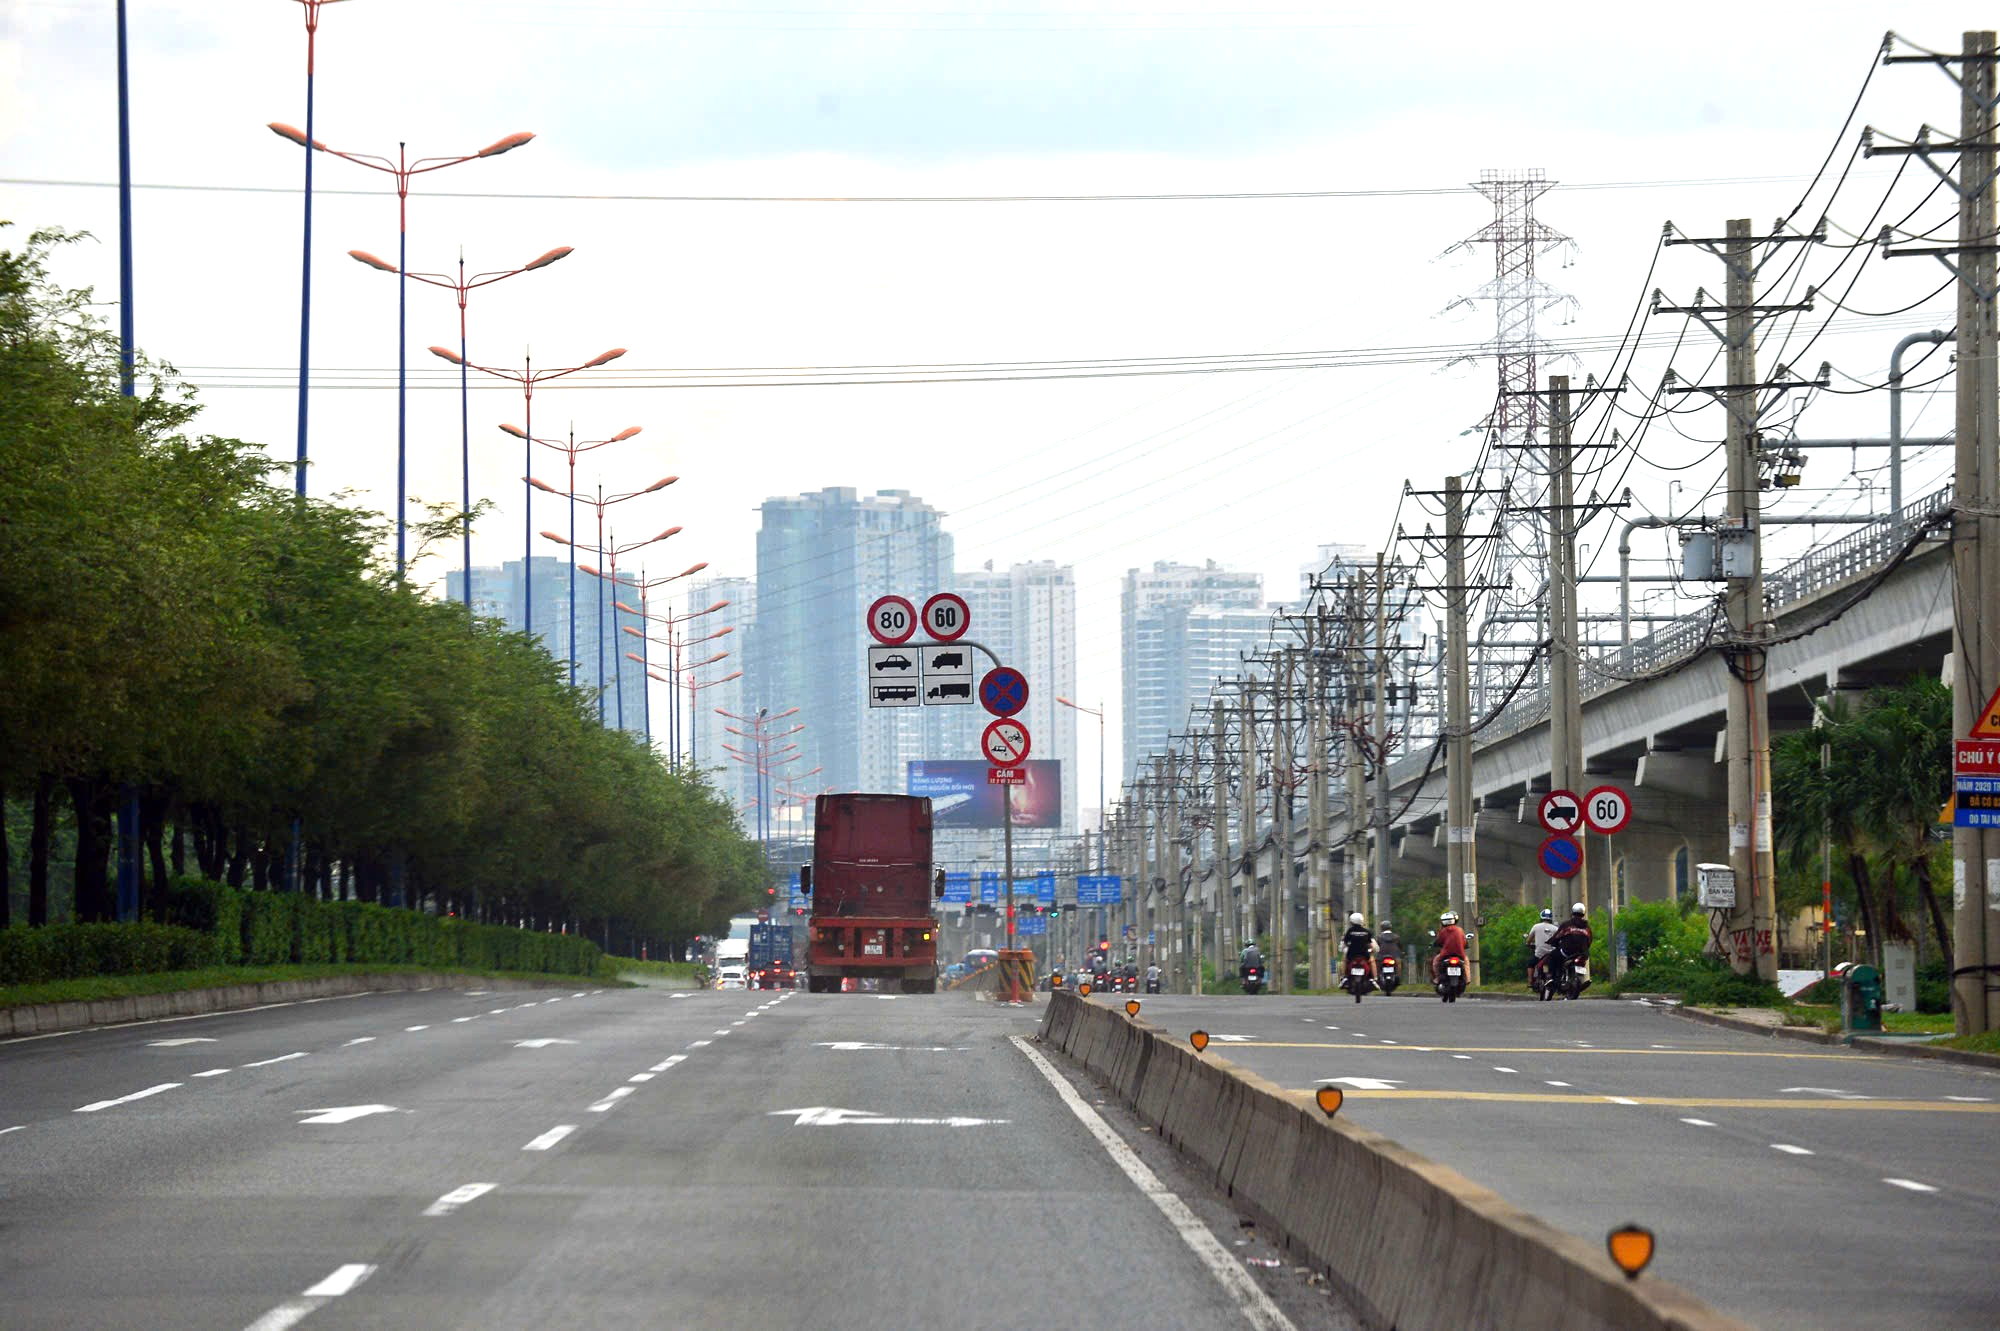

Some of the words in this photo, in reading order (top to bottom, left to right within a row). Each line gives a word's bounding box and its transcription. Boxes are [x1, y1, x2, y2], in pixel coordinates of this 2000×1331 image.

[880, 611, 905, 629] 80
[935, 607, 956, 628] 60
[1958, 748, 1984, 764] CHÚ
[1975, 781, 1991, 792] 2020
[1596, 799, 1618, 820] 60
